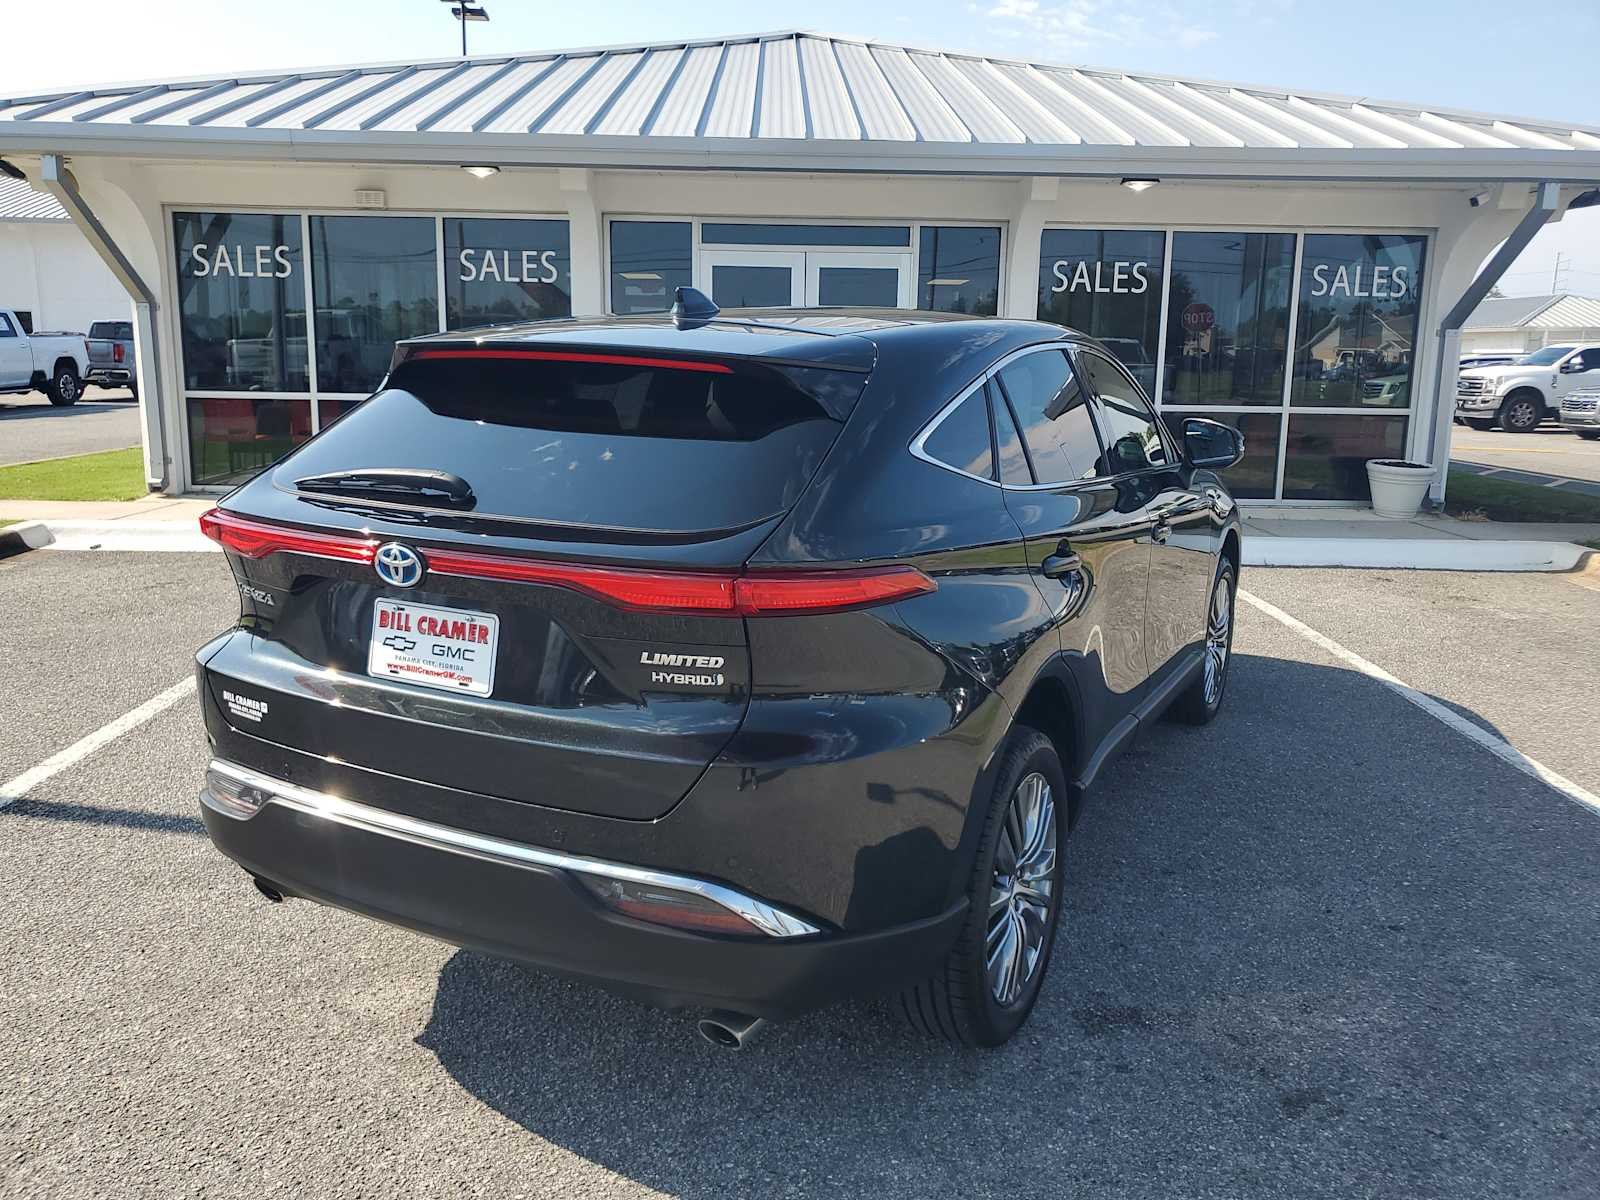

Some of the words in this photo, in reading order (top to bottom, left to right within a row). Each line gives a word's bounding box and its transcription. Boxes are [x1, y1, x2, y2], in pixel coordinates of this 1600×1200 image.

[192, 244, 292, 279] SALES
[459, 248, 559, 284] SALES
[1051, 260, 1148, 294] SALES
[1311, 264, 1408, 298] SALES
[378, 609, 411, 632] BILL
[417, 615, 489, 645] CRAMER
[431, 644, 476, 662] GMC
[640, 651, 725, 668] LIMITED
[651, 672, 712, 686] HYBRID
